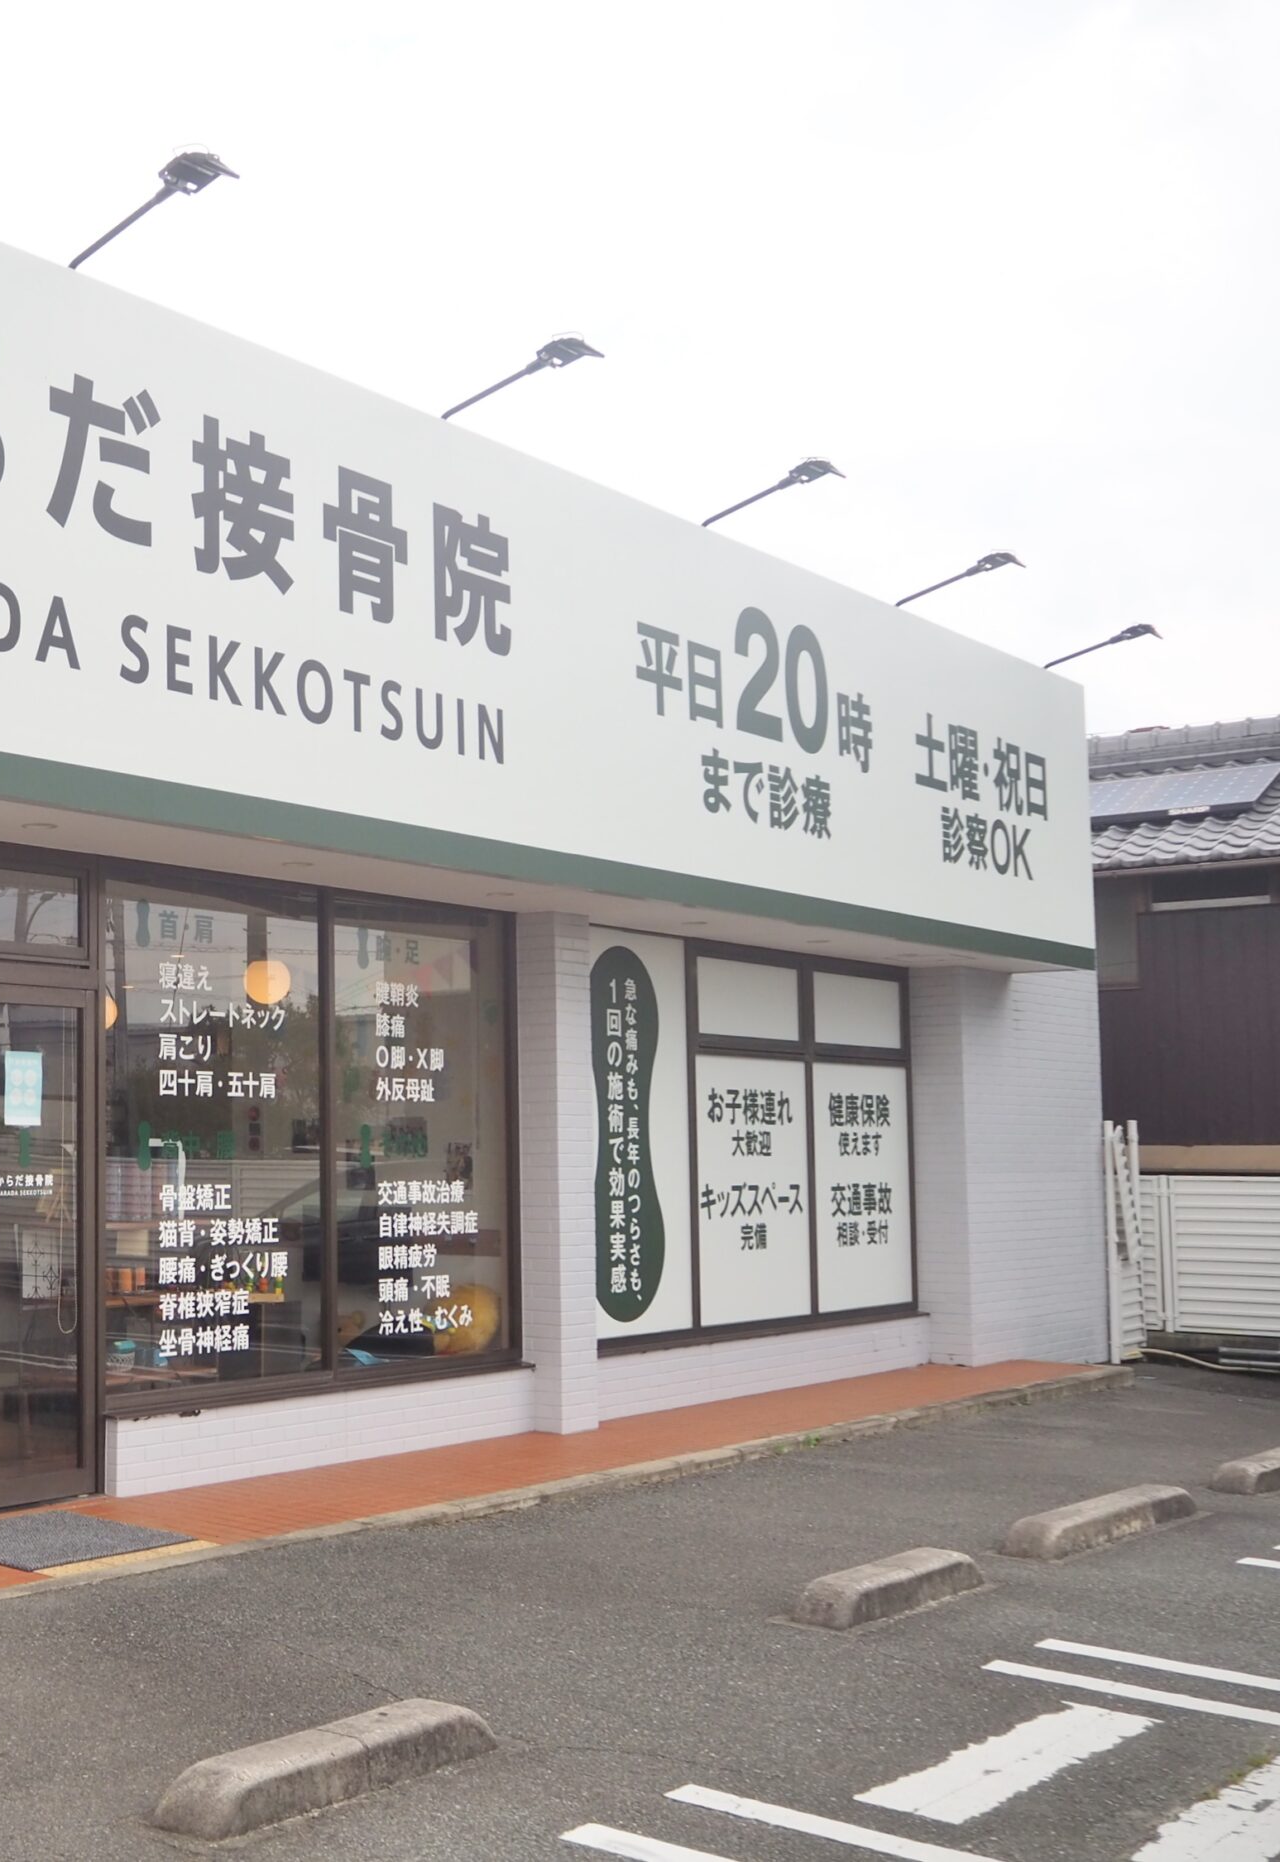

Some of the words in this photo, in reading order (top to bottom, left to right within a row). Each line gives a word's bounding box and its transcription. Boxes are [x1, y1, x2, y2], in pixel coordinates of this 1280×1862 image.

[120, 614, 505, 765] SEKKOTSUIN
[636, 606, 873, 774] 平日20時
[915, 712, 1049, 822] 土曜・祝日
[700, 747, 832, 840] まで診療
[940, 806, 1034, 881] 診察OK
[158, 961, 213, 992] 寝違え
[375, 981, 419, 1008] 腱鞘炎
[159, 999, 287, 1031] ストレートネック
[375, 1013, 406, 1039] 膝痛
[158, 1033, 212, 1062] 肩こり
[158, 1069, 277, 1099] 四十肩・五十肩
[375, 1076, 436, 1102] 外反母趾
[706, 1087, 794, 1126] お子様連れ
[828, 1092, 891, 1128] 健康保険
[606, 978, 628, 1294] 1回の施術で効果実感
[624, 978, 643, 1301] 急な痛みも、長年のつらさも、
[731, 1130, 772, 1157] 大歓迎
[838, 1132, 882, 1157] 使えます
[19, 1188, 53, 1197] SEKKOTSUIN
[159, 1183, 232, 1212] 骨盤矯正
[377, 1180, 465, 1206] 交通事故治療
[700, 1182, 803, 1219] キッズスペース
[830, 1182, 892, 1218] 交通事故
[158, 1217, 280, 1249] 猫背・姿勢矯正
[378, 1210, 479, 1239] 自律神経失調症
[740, 1223, 768, 1251] 完備
[836, 1219, 889, 1248] 相談・受付
[158, 1251, 289, 1285] 腰痛・ぎっくり腰
[378, 1243, 438, 1271] 眼精疲労
[158, 1288, 250, 1321] 脊椎狭窄症
[378, 1274, 451, 1303] 頭痛・不眠
[378, 1304, 473, 1336] 冷え性・むくみ
[158, 1323, 250, 1358] 坐骨神経痛
